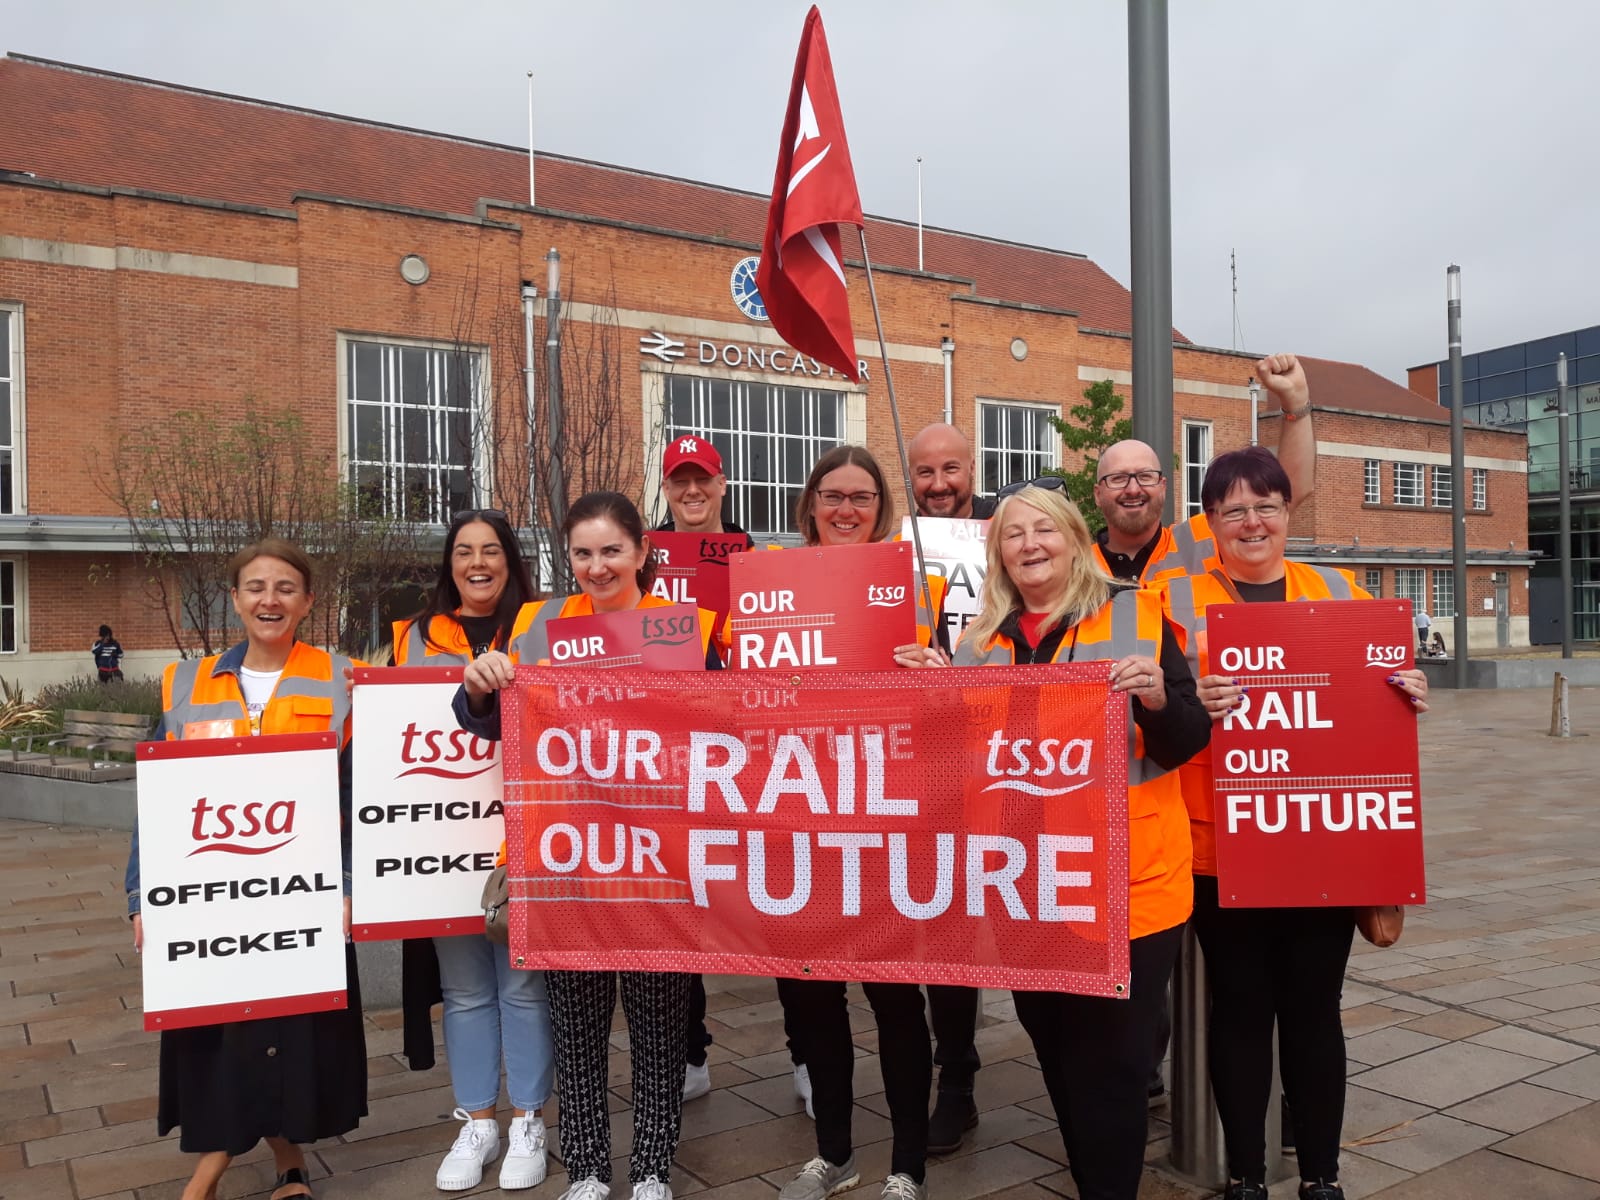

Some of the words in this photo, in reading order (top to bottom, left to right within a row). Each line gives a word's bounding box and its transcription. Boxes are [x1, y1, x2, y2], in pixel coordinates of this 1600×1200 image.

[699, 340, 870, 381] DONCASR
[738, 590, 795, 614] OUR
[868, 584, 906, 601] tssa
[641, 614, 694, 639] tssa
[552, 636, 606, 661] OUR
[739, 629, 837, 670] RAIL
[1220, 646, 1286, 671] OUR
[1366, 643, 1406, 661] tssa
[1223, 690, 1333, 731] RAIL
[400, 722, 497, 764] tssa
[986, 729, 1094, 777] tssa
[536, 727, 662, 780] OUR
[688, 731, 919, 816] RAIL
[1225, 749, 1290, 773] OUR
[191, 797, 296, 841] tssa
[1226, 791, 1416, 834] FUTURE
[375, 852, 500, 878] PICKE
[539, 822, 668, 874] OUR
[688, 829, 1097, 923] FUTURE
[147, 872, 338, 907] OFFICIAL
[167, 927, 322, 962] PICKET
